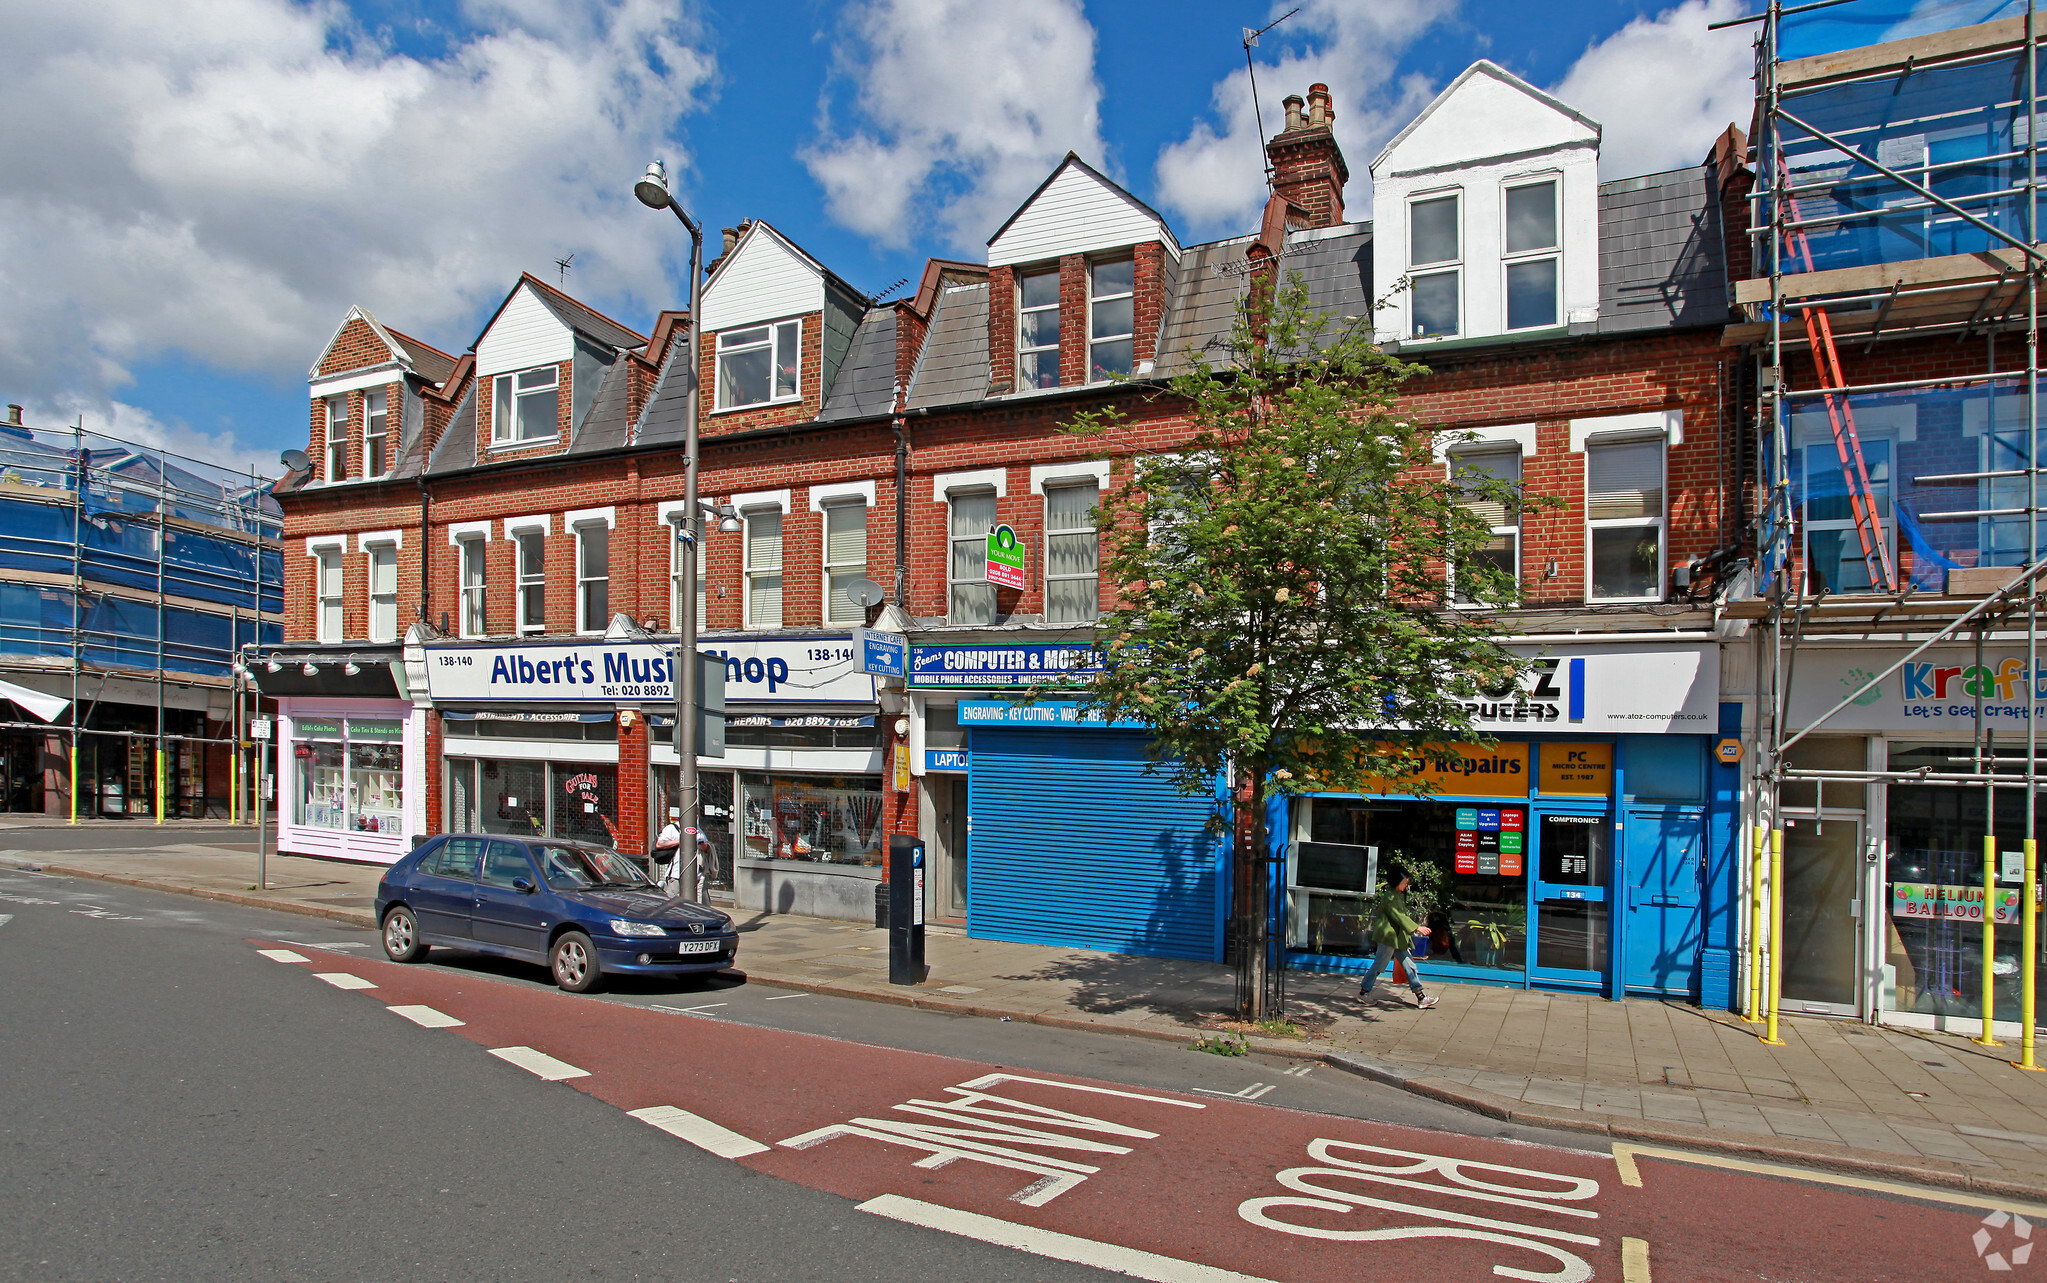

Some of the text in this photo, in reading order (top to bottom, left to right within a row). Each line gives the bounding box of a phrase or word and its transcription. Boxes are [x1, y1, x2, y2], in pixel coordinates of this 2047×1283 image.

[991, 549, 1021, 562] YOUR MOVE
[864, 631, 902, 644] INTERNET CAFE
[869, 642, 898, 654] ENGRAVING
[438, 656, 473, 666] 138-140
[913, 651, 943, 671] Seems
[944, 650, 1026, 670] COMPUTER
[1028, 652, 1041, 670] &
[491, 653, 595, 684] Albert's
[603, 651, 675, 683] Musi
[878, 665, 900, 675] CUTTING
[914, 675, 939, 684] MOBILE
[940, 675, 963, 684] PHONE
[963, 675, 1013, 685] ACCESSORIES
[601, 685, 670, 696] Tel: 020 8892
[529, 713, 580, 722] ACCESSORIES
[963, 706, 1004, 720] ENGRAVING
[1009, 707, 1022, 720] KEY
[1023, 707, 1055, 721] CUTTING
[1607, 713, 1708, 721] www.atoz-computers.co.uk
[1904, 705, 1943, 718] Let's
[734, 716, 772, 726] REPAIRS
[805, 716, 831, 727] 8892
[1568, 751, 1587, 762] PC
[1434, 755, 1521, 777] Repairs
[565, 773, 598, 794] GUITARS
[581, 791, 599, 804] SALE
[1549, 816, 1600, 824] COMPTRONICS
[913, 848, 920, 863] P
[1565, 891, 1581, 899] 134
[1906, 901, 2007, 920] BALLOOS
[683, 942, 704, 952] Y273
[776, 1072, 1206, 1208] LANE
[1238, 1138, 1600, 1283] BUS
